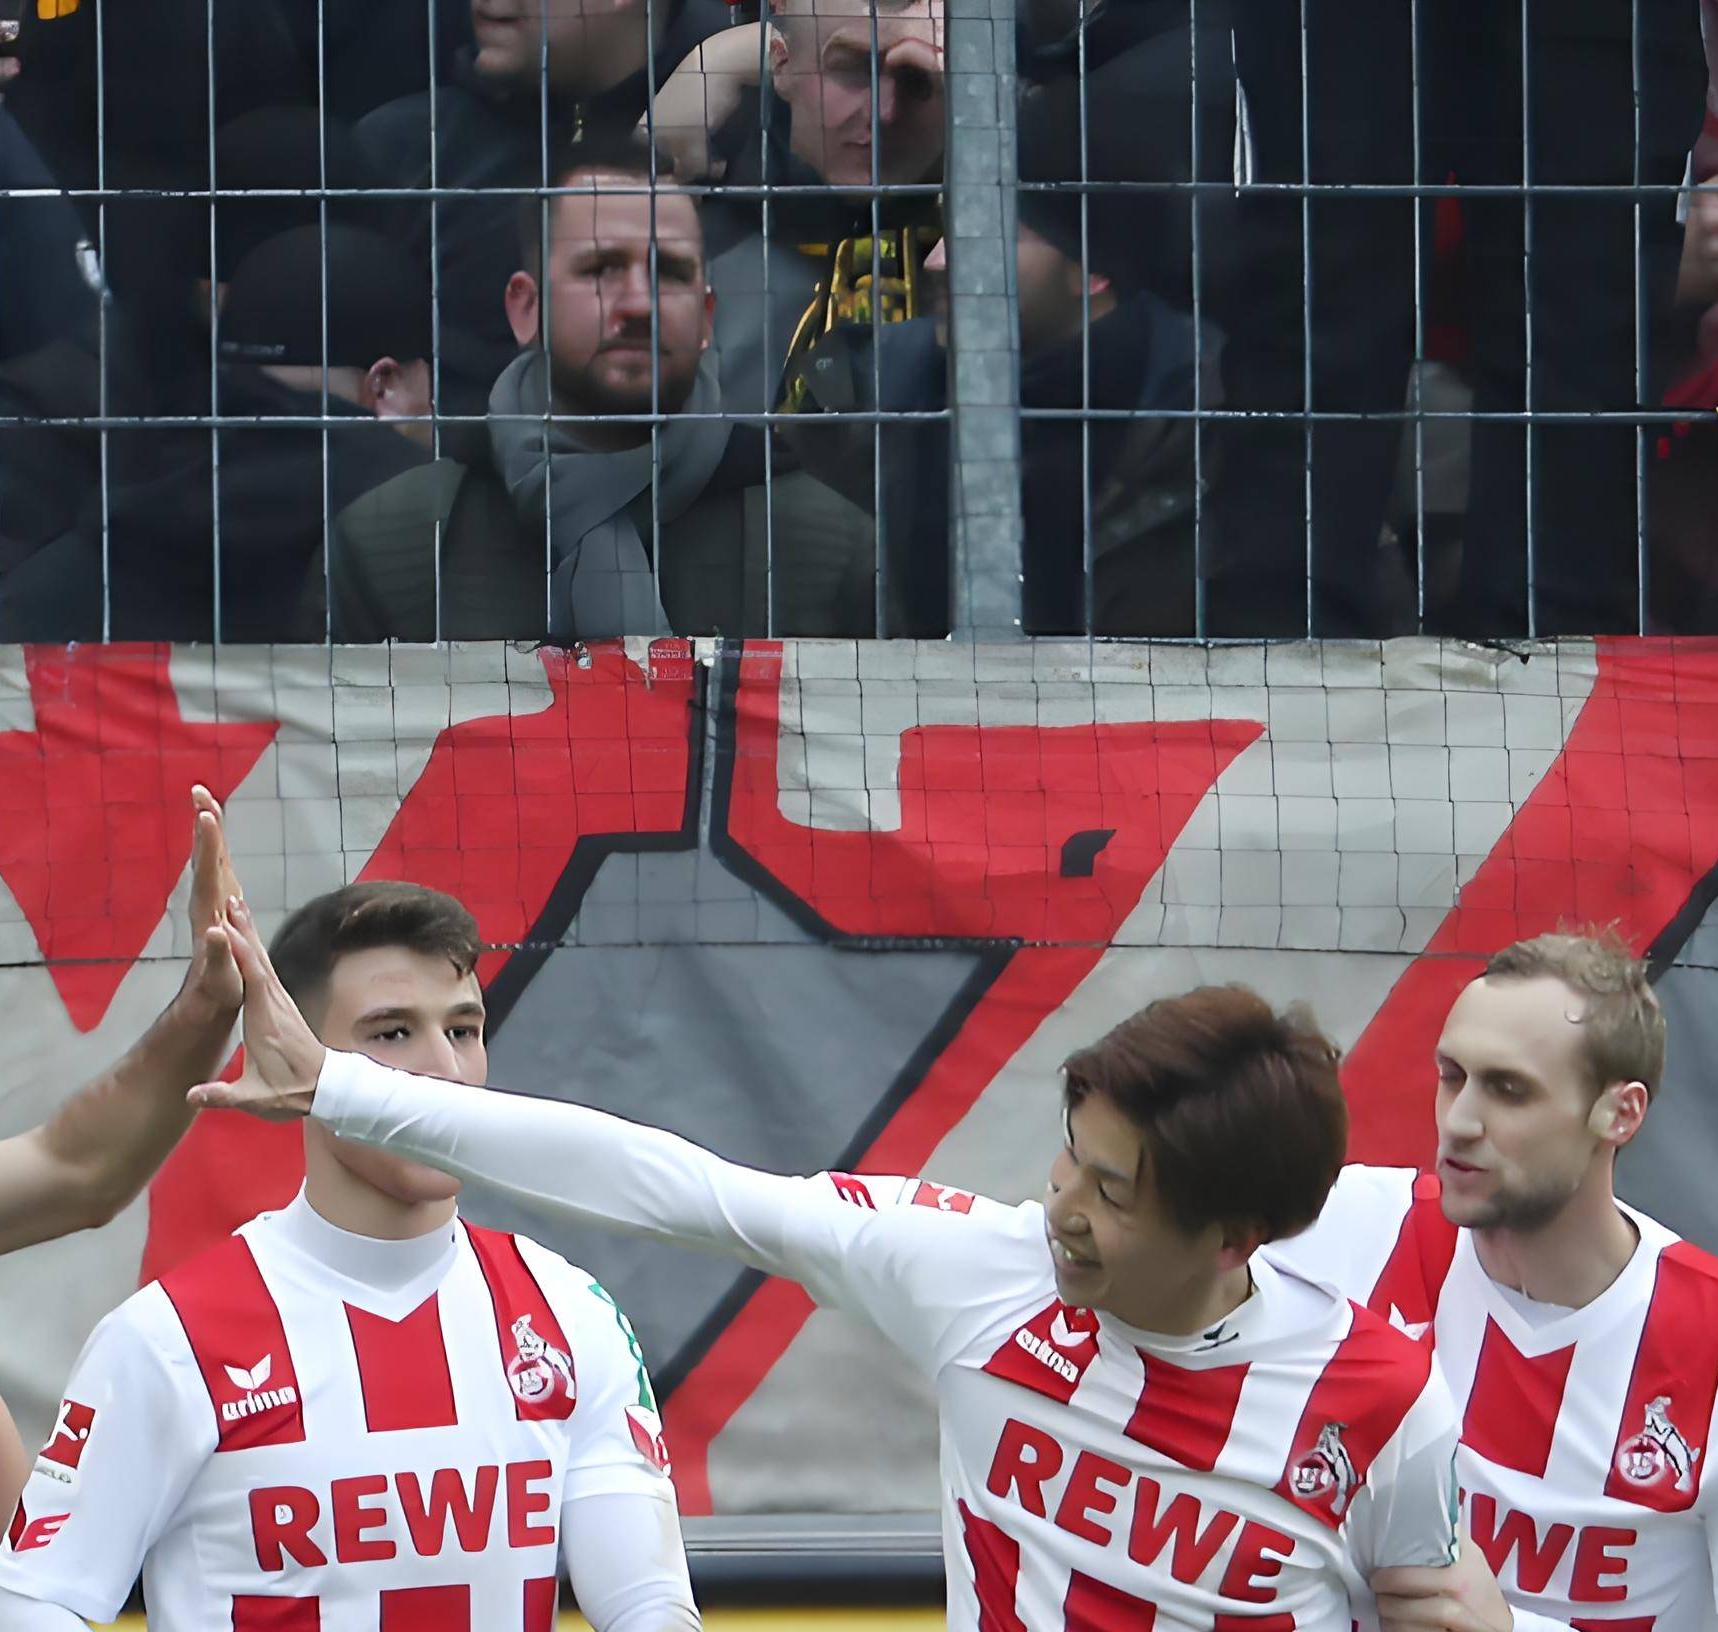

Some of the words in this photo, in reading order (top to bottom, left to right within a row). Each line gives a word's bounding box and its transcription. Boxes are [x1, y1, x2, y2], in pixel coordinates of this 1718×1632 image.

[248, 1459, 555, 1572] REWE
[985, 1417, 1296, 1603] REWE
[1459, 1486, 1638, 1603] WE
